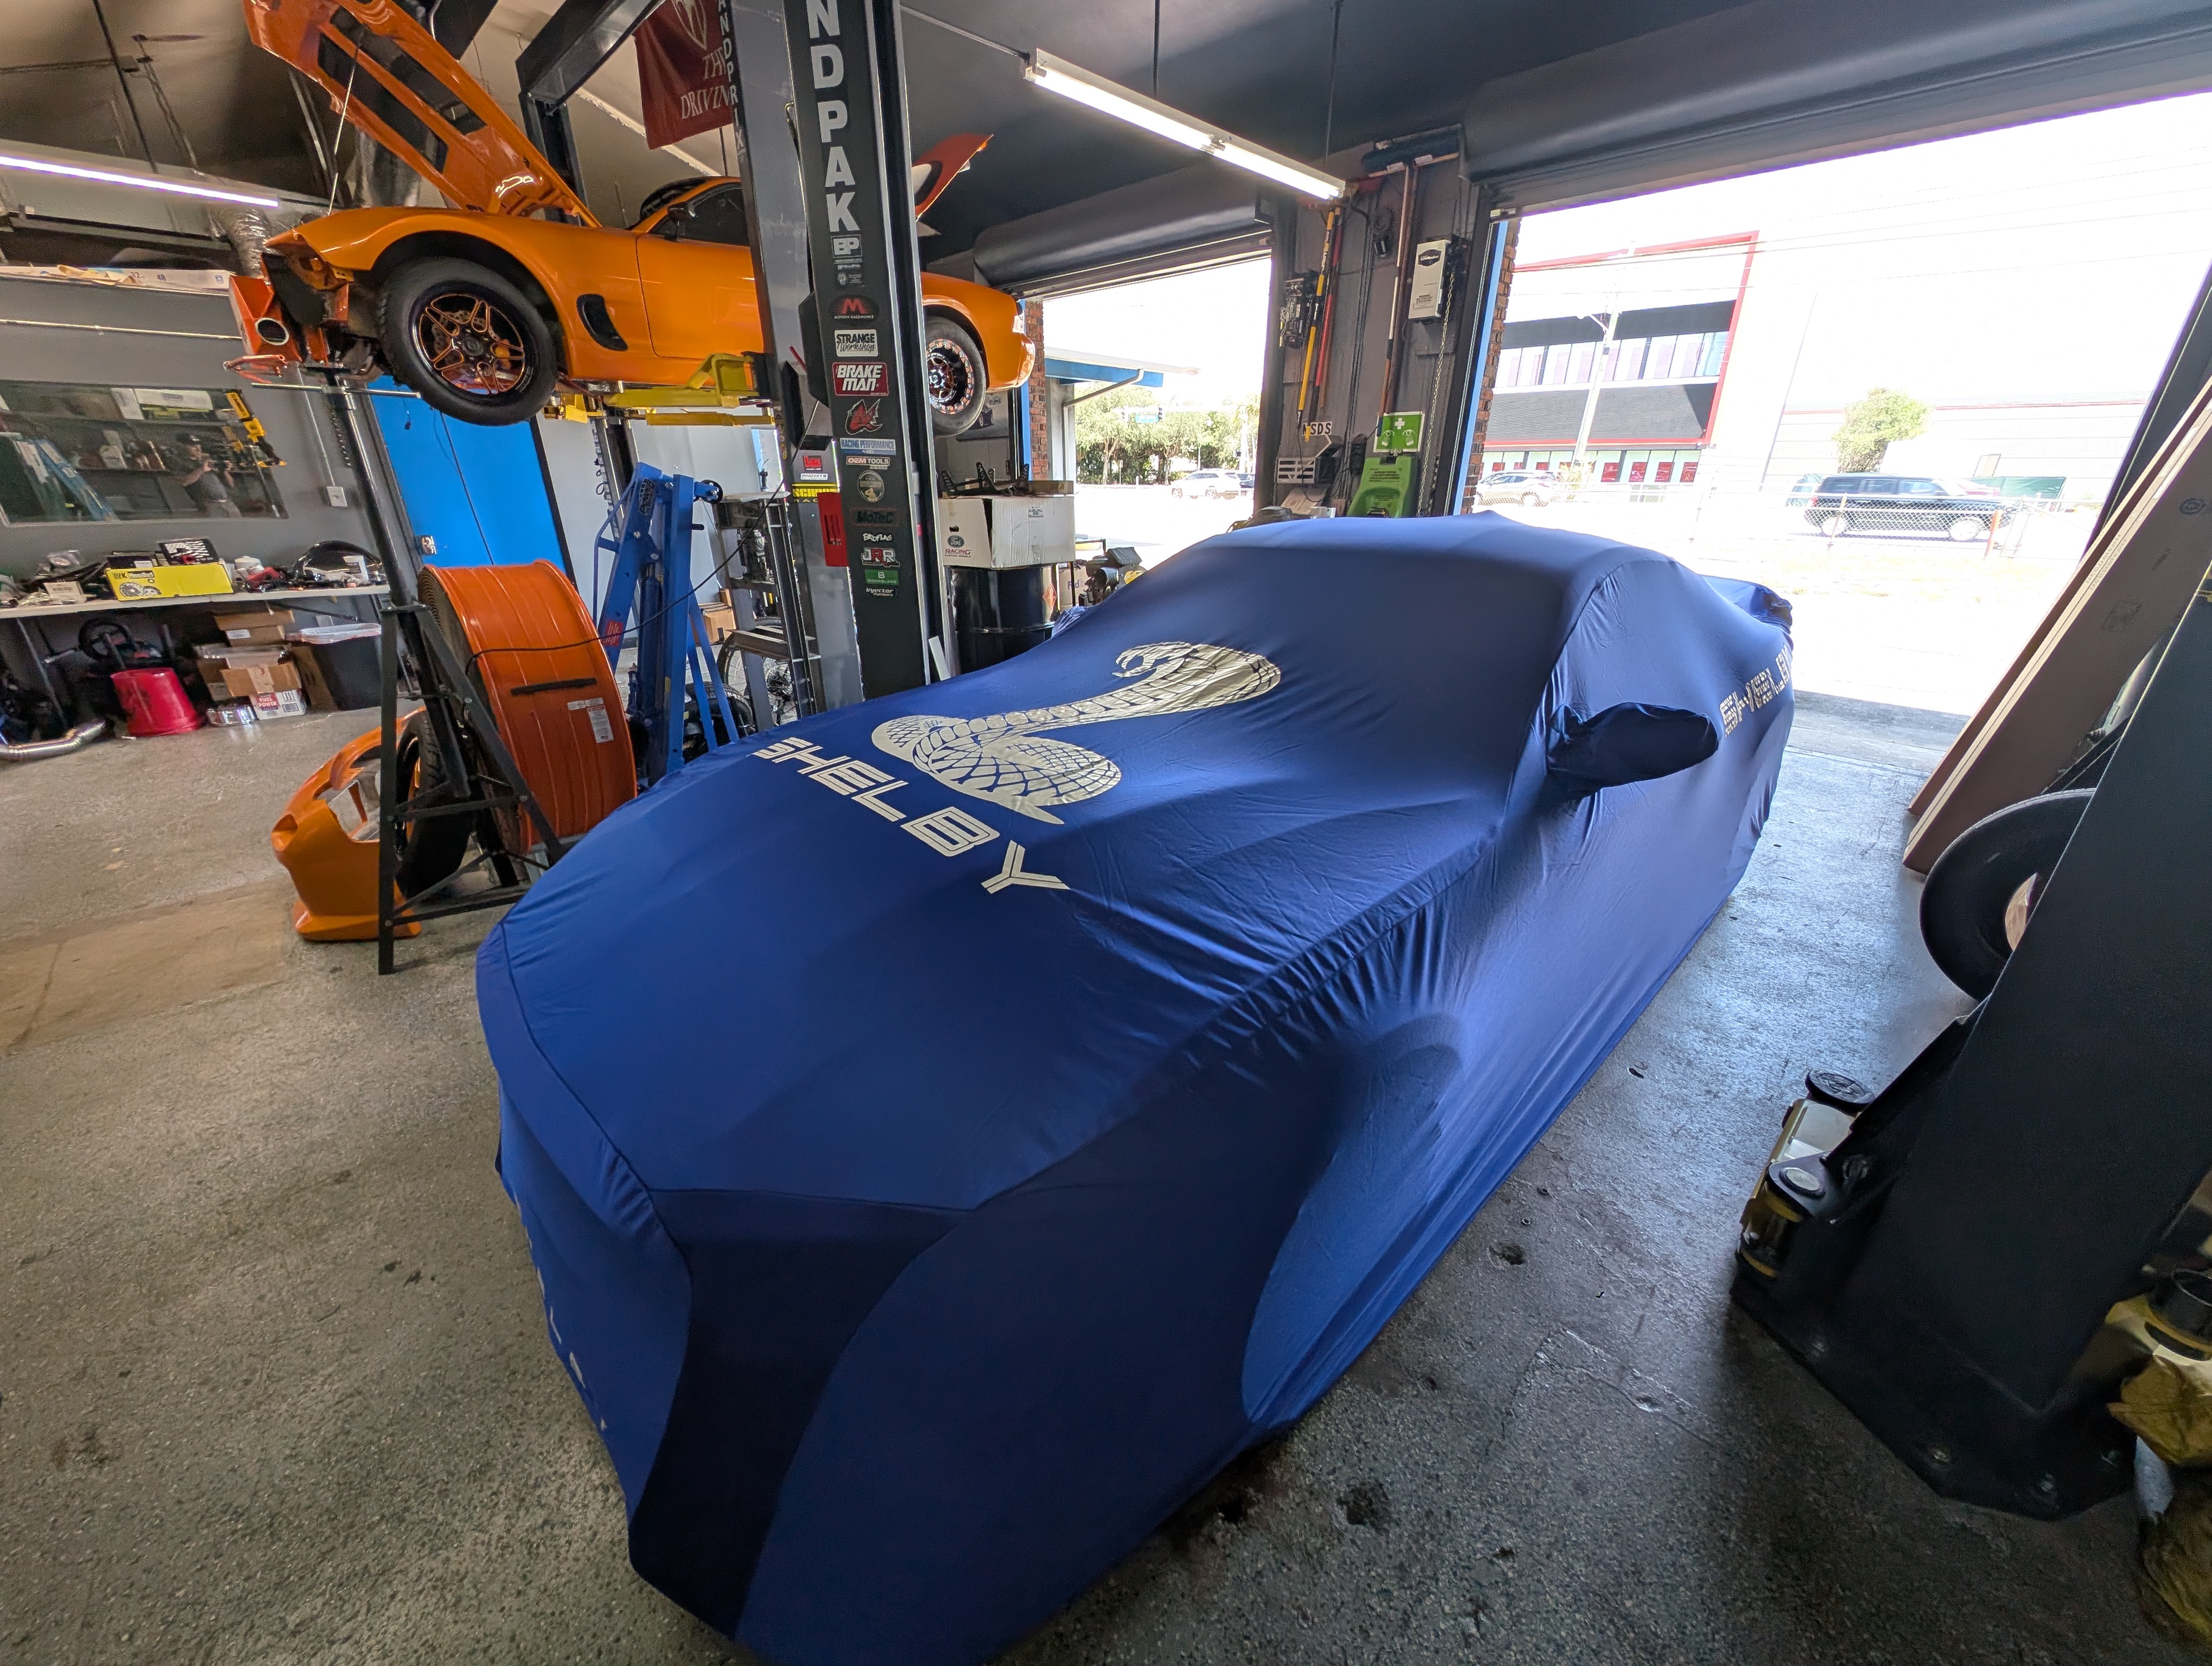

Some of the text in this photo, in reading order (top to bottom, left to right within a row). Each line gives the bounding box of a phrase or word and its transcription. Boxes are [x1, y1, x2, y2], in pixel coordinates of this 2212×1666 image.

[837, 334, 874, 343] STRANGE
[837, 342, 874, 353] Workshop
[837, 365, 882, 378] BRAKE
[842, 378, 877, 390] MAN
[860, 440, 895, 449] PERFORMANCE
[862, 549, 895, 566] JRR
[749, 737, 1071, 894] SHELBY
